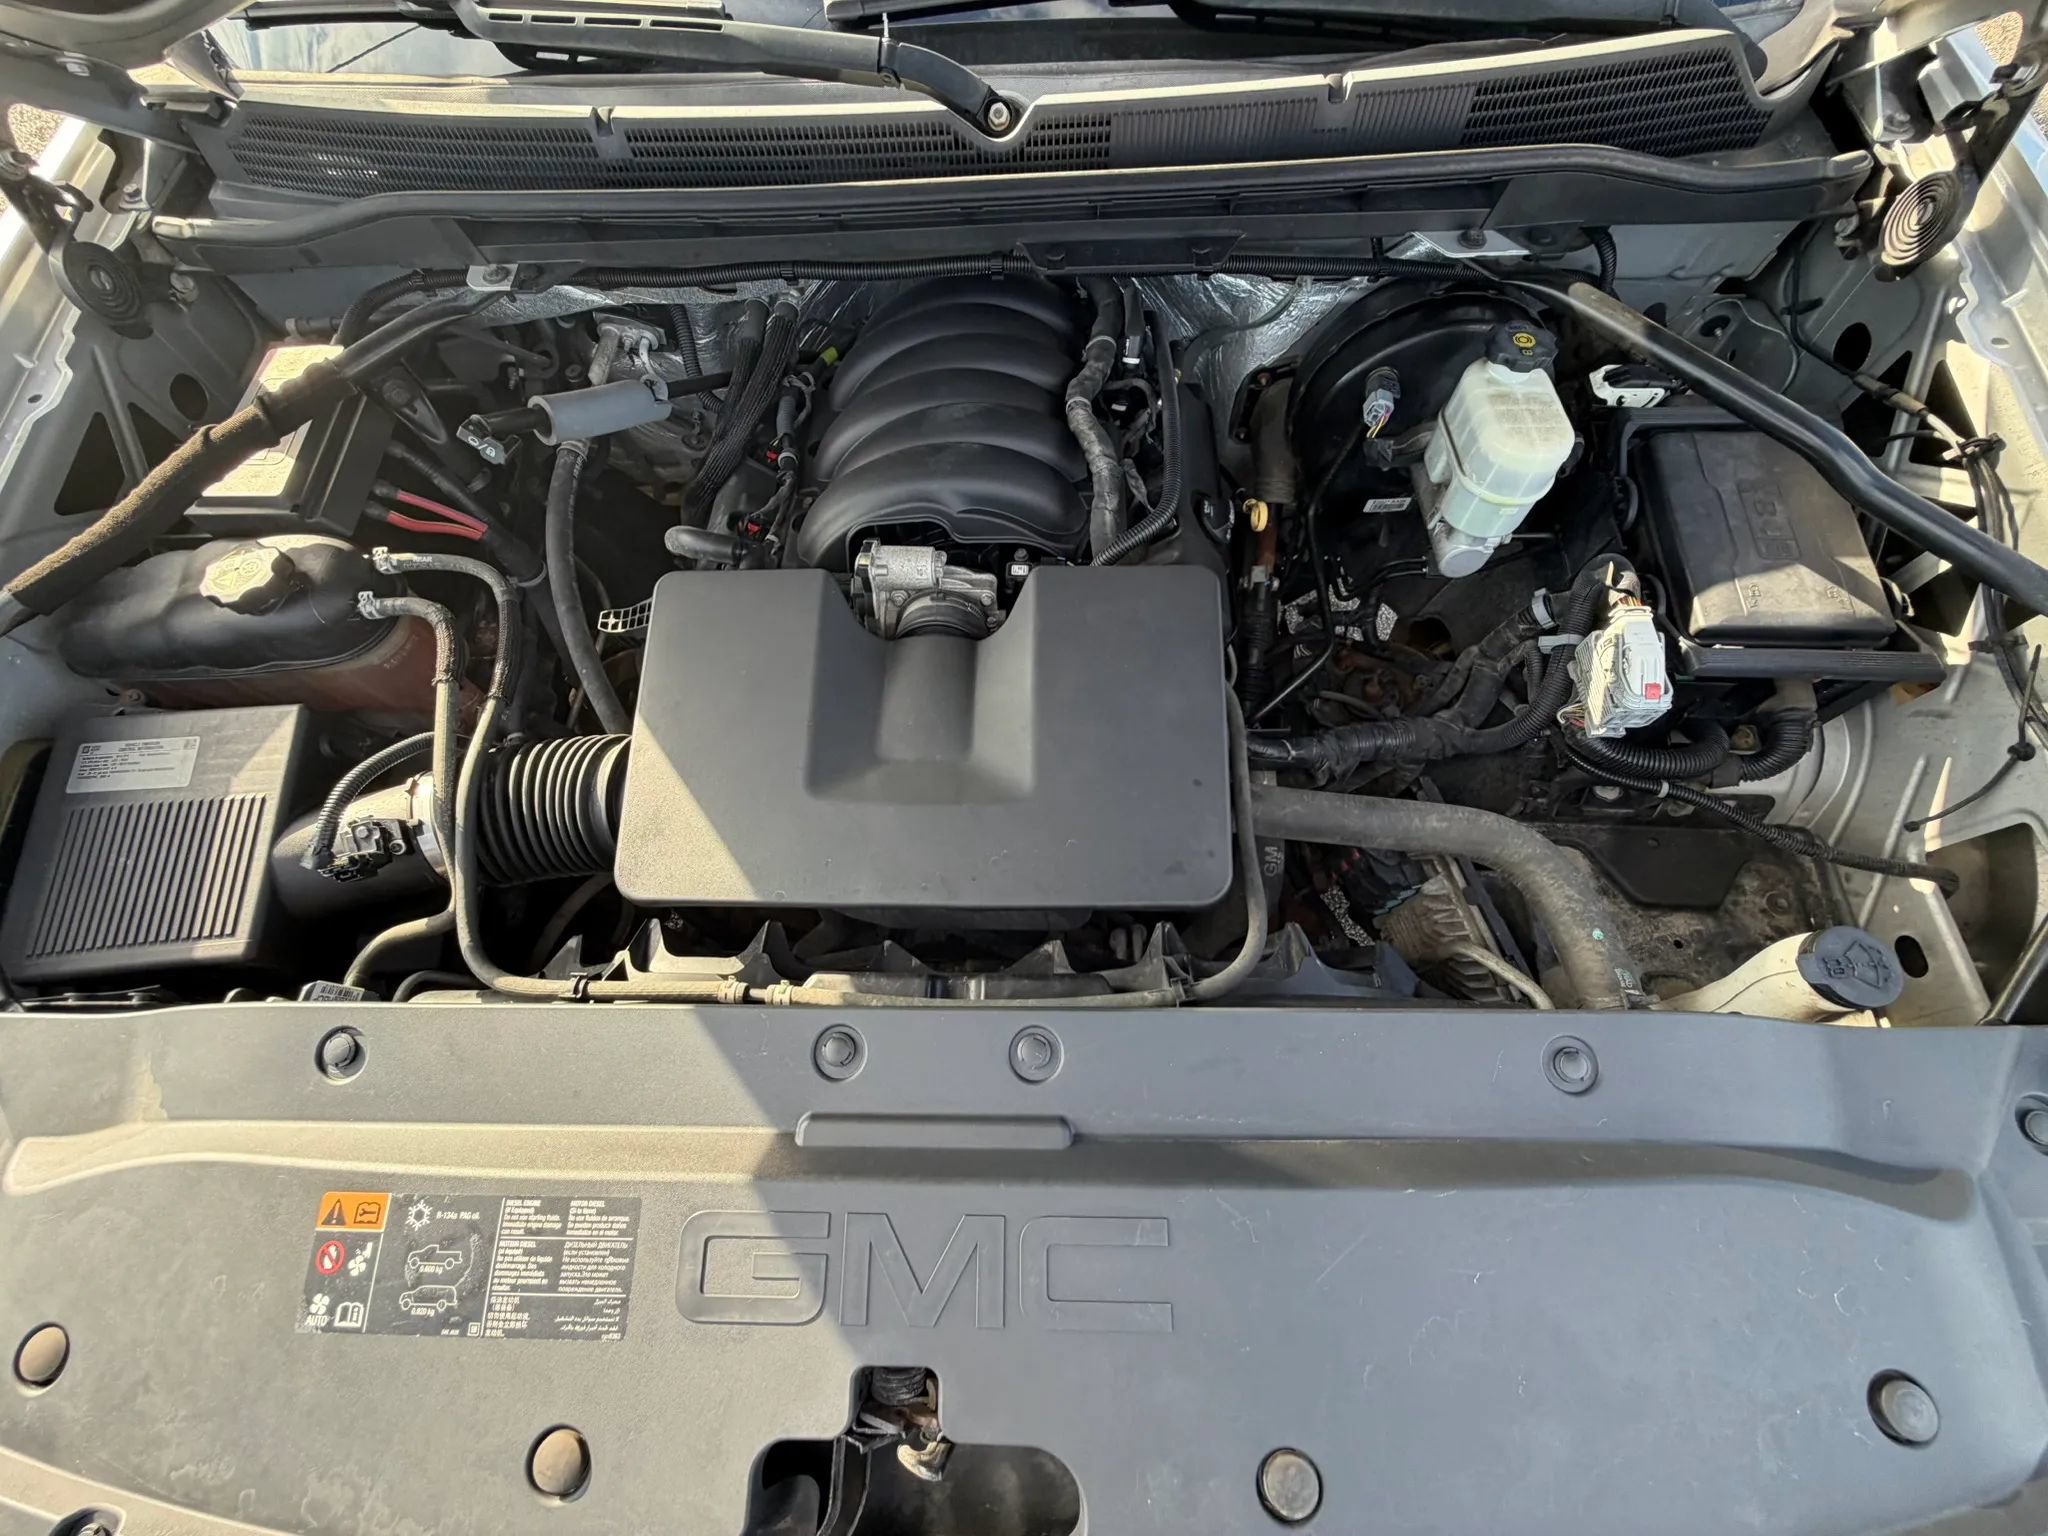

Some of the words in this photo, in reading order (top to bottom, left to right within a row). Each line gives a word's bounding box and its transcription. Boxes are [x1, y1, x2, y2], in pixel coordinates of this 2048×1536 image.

[1264, 846, 1278, 877] GM
[676, 1209, 1174, 1333] GMC
[304, 1316, 329, 1327] AUTO
